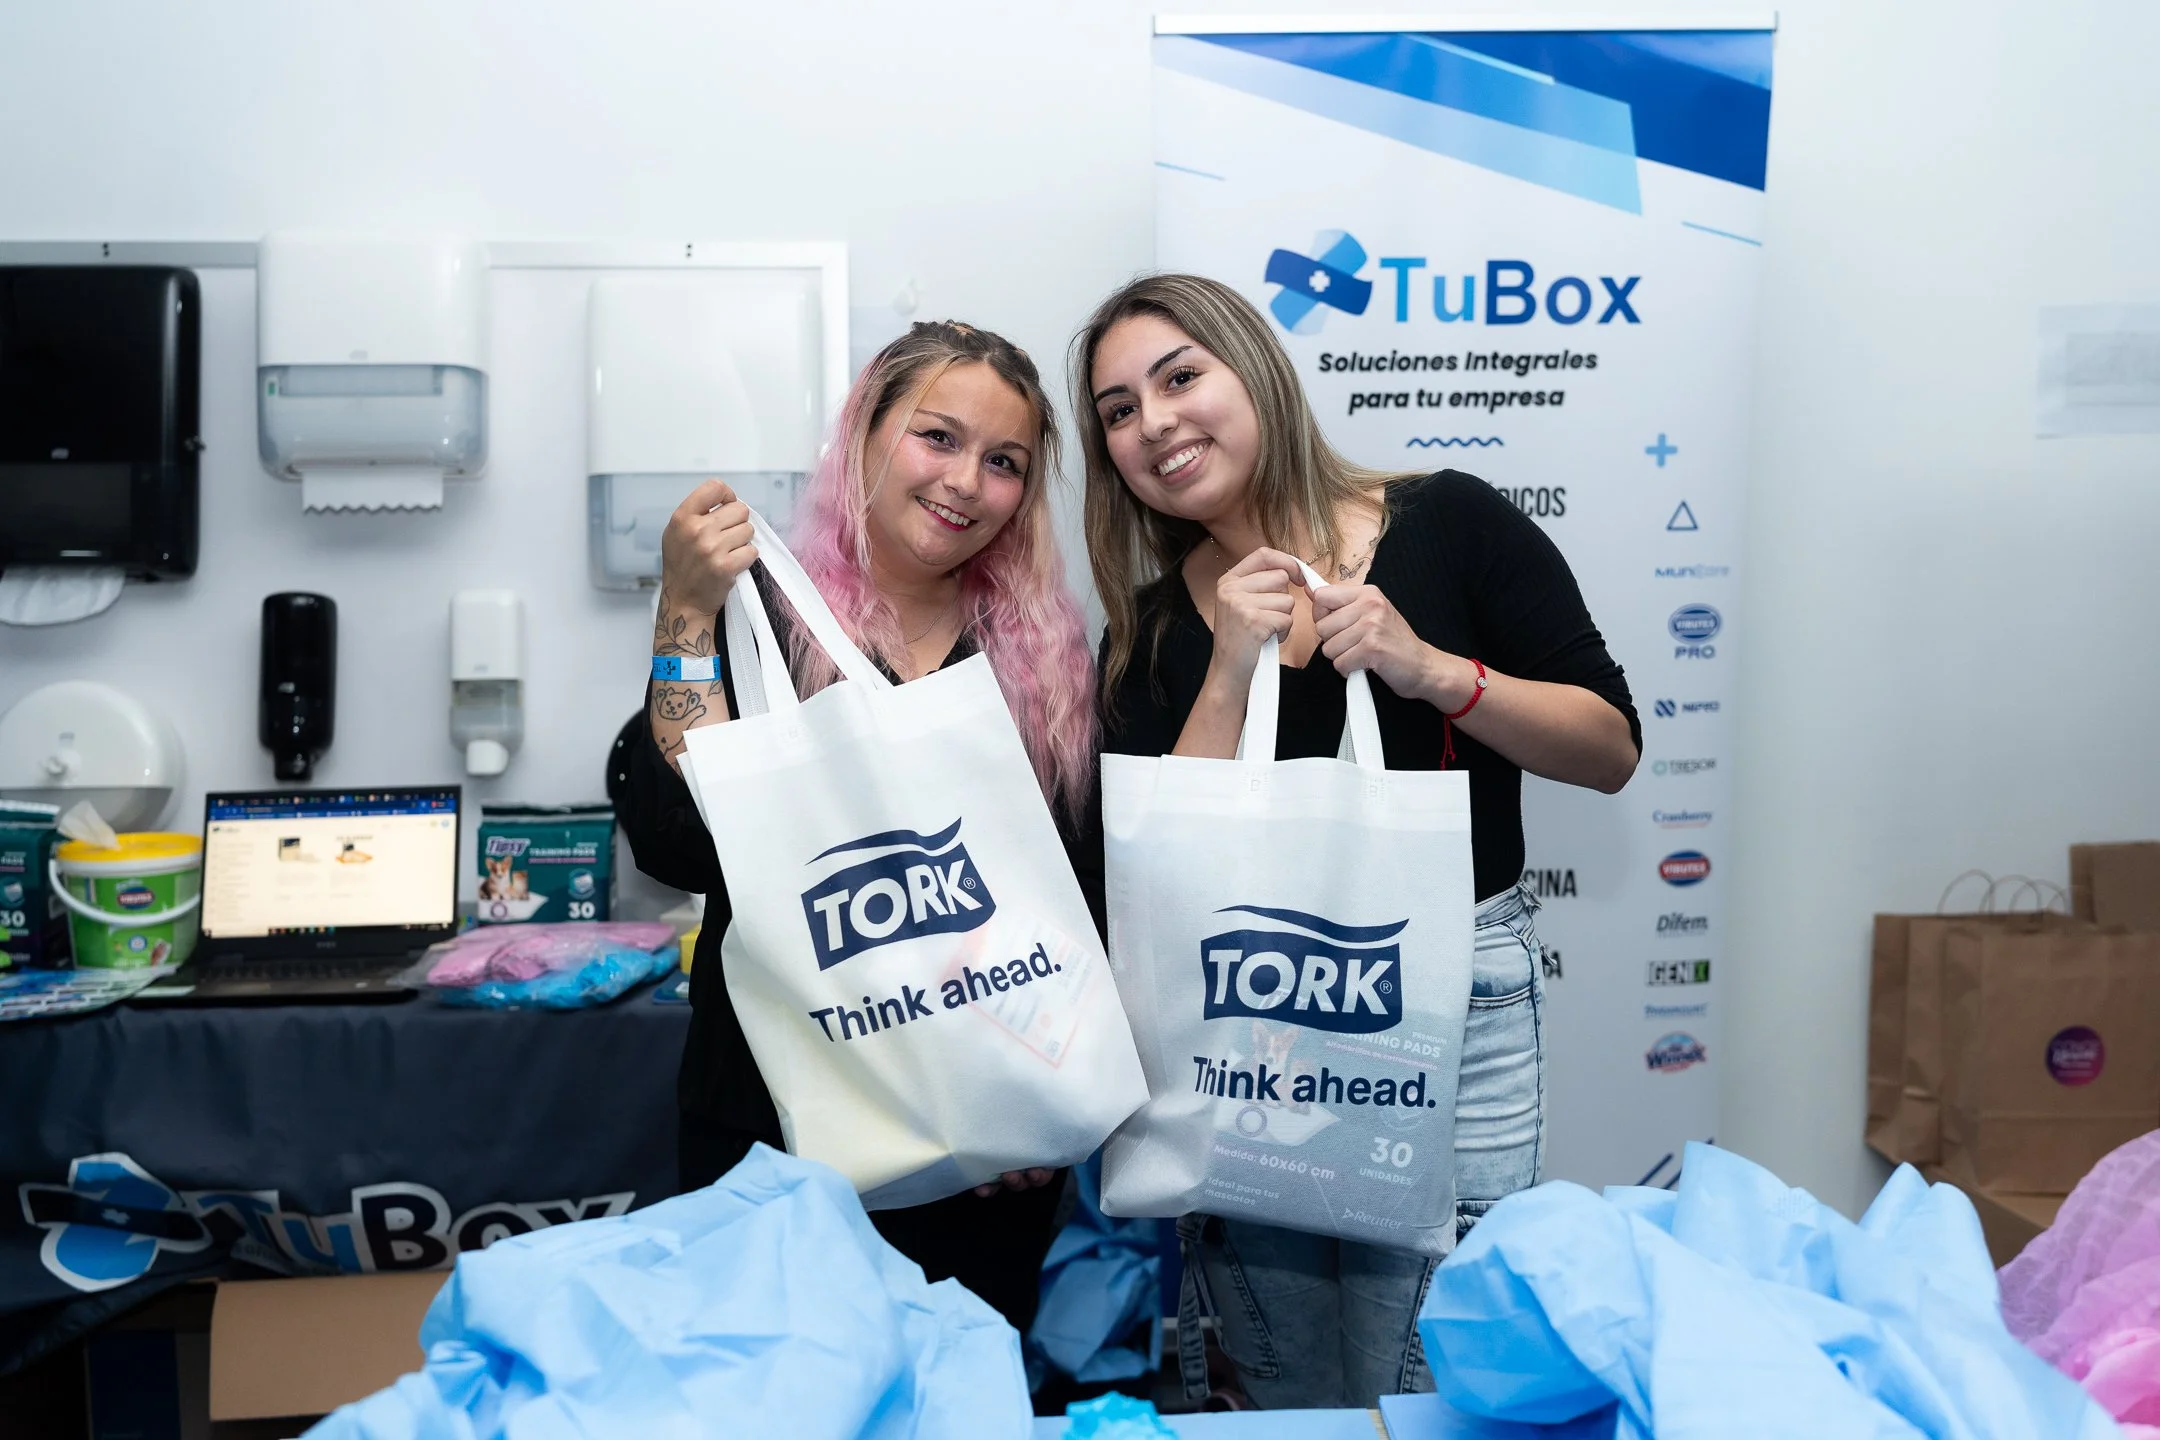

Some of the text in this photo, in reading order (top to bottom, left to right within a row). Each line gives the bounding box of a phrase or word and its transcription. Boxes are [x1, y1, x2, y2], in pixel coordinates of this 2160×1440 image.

[1378, 256, 1643, 326] TuBox
[1318, 349, 1598, 378] Soluciones Integrales
[1348, 387, 1565, 415] para tu empresa
[1490, 482, 1567, 518] ICOS
[1674, 645, 1717, 660] PRO
[567, 901, 596, 919] 30
[808, 985, 935, 1043] Think
[940, 942, 1062, 1010] ahead.
[1403, 1040, 1441, 1058] PADS
[1193, 1055, 1437, 1109] Think ahead.
[1369, 1136, 1414, 1168] 30
[1259, 1153, 1307, 1174] 60x60
[1310, 1166, 1335, 1180] cm
[1359, 1167, 1415, 1185] UNIDADES
[1204, 1188, 1257, 1206] mascotas
[1208, 1177, 1280, 1199] Ideal para tus
